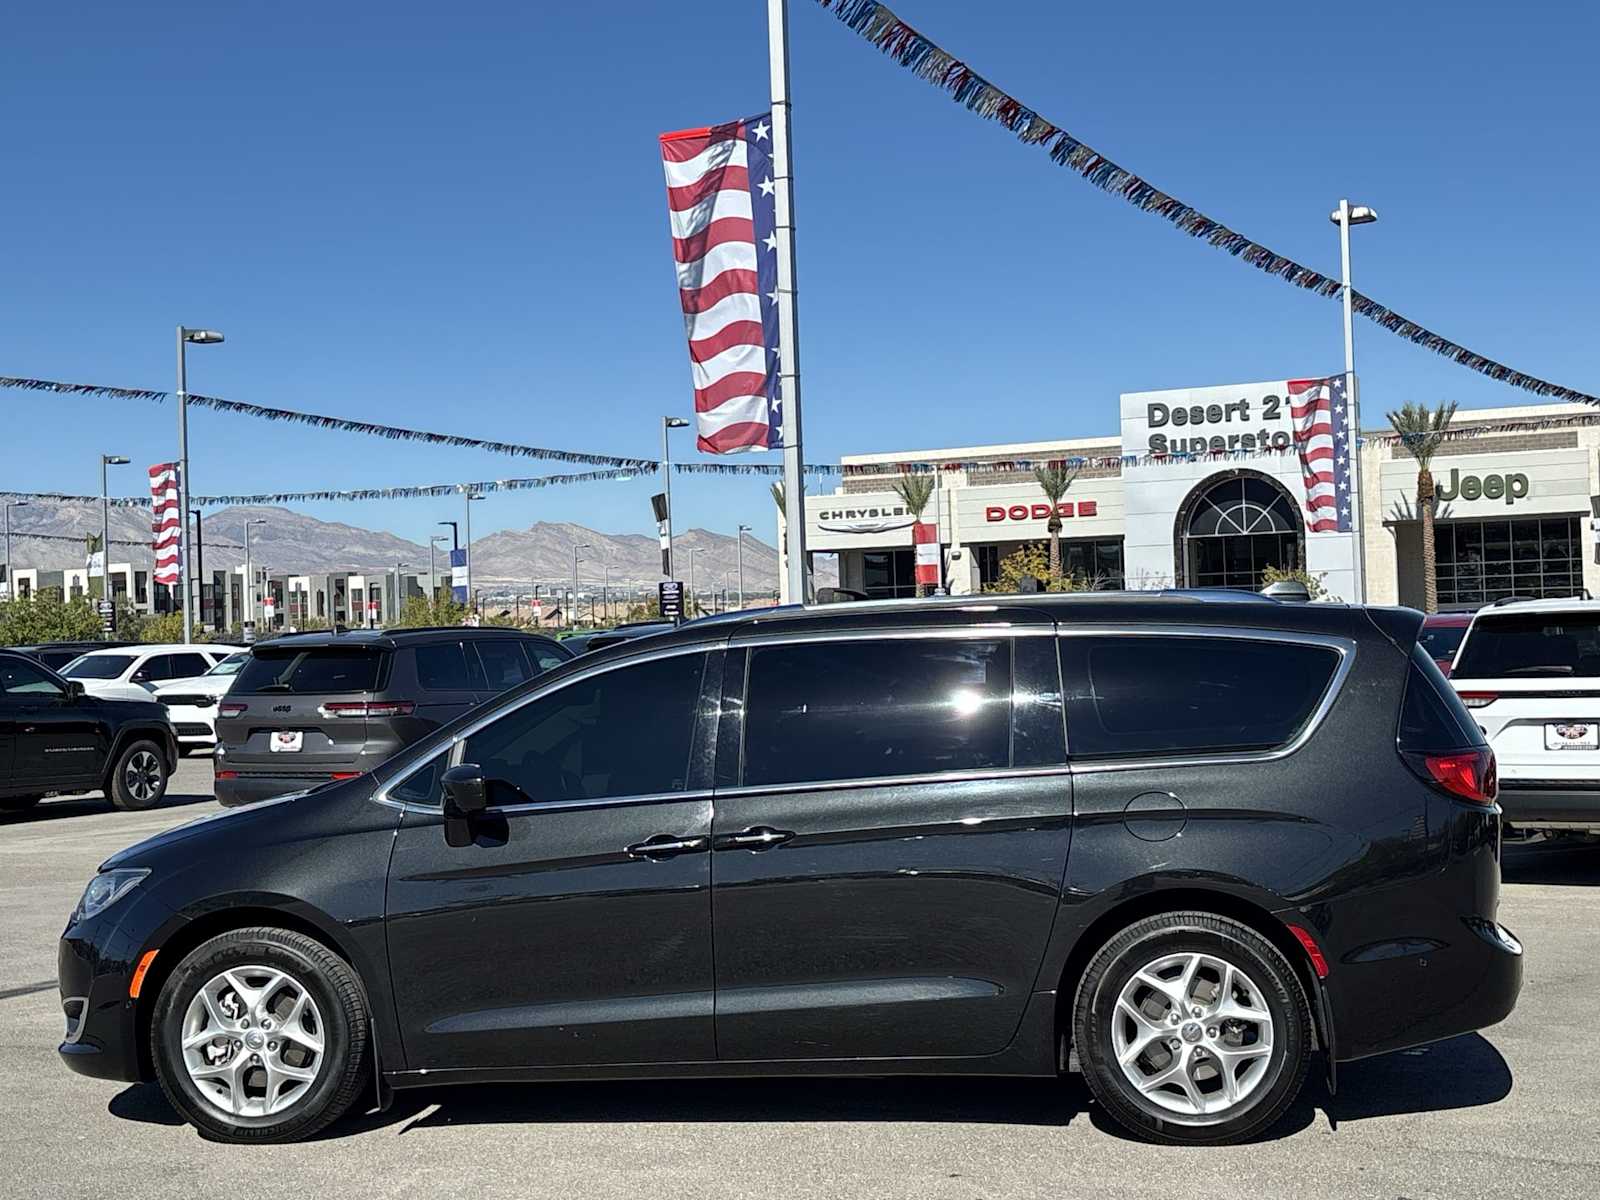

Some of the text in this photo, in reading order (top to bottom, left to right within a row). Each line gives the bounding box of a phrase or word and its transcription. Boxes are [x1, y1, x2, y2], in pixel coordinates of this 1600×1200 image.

[1147, 394, 1290, 428] Desert 2
[1148, 428, 1290, 455] Supersto
[1435, 468, 1529, 505] Jeep
